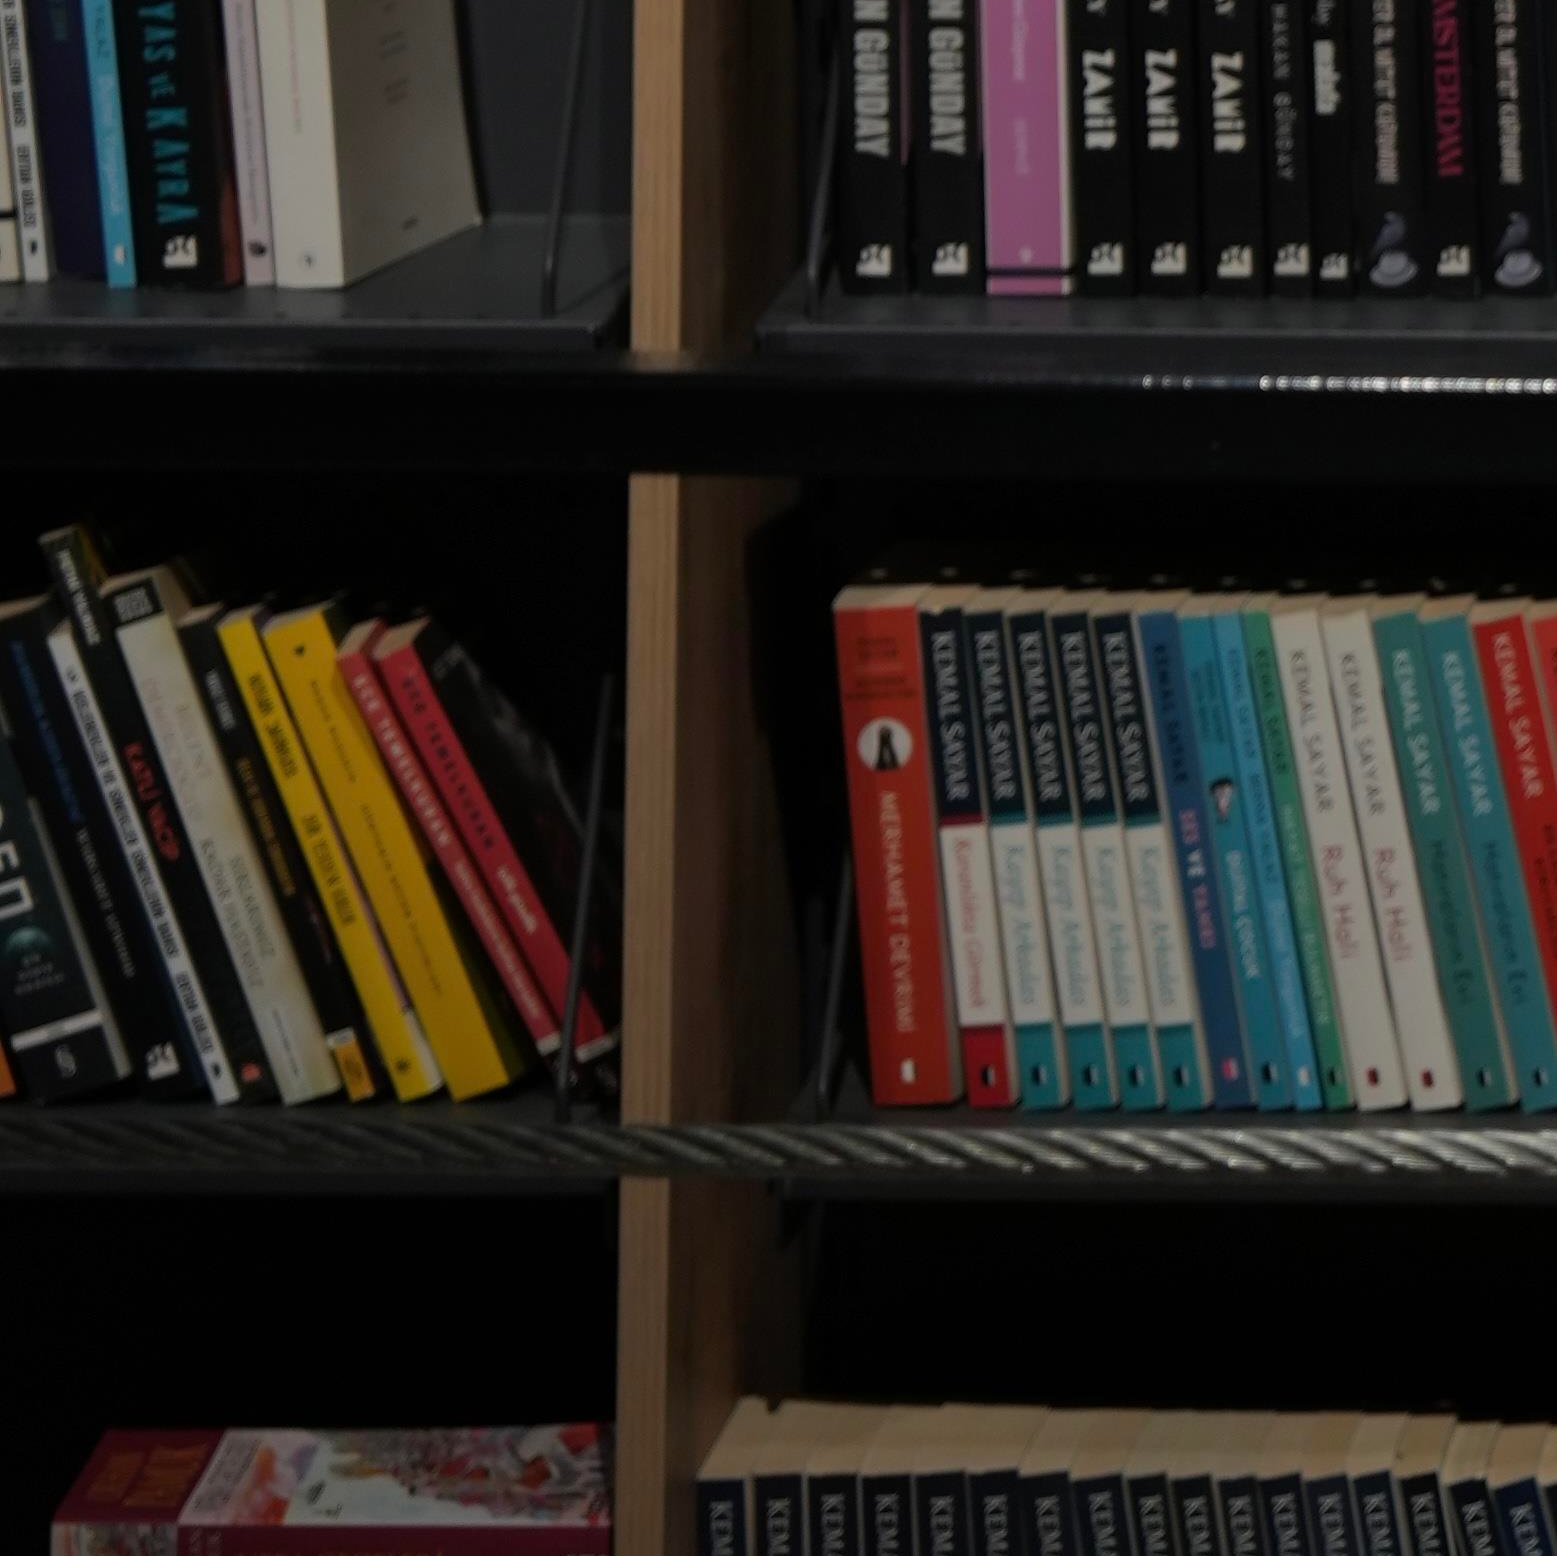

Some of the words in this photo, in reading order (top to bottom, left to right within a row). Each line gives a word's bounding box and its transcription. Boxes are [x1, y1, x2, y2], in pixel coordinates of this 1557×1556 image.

[1491, 631, 1524, 714] KEMAL
[1511, 717, 1544, 801] SAYAR
[1374, 848, 1401, 899] Ruh
[1383, 906, 1413, 963] Hali
